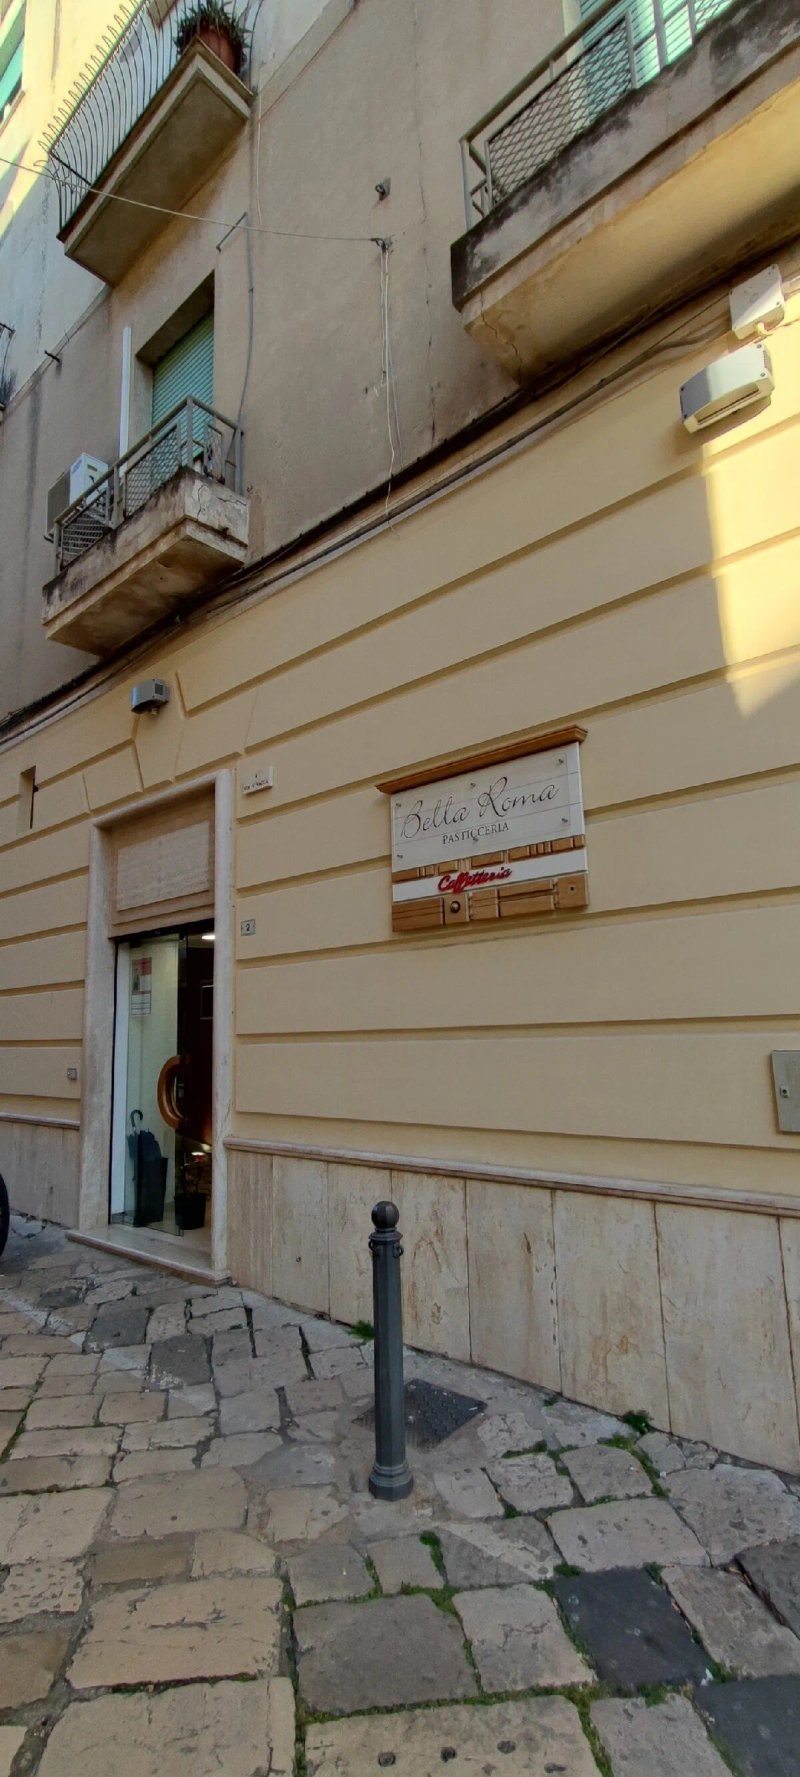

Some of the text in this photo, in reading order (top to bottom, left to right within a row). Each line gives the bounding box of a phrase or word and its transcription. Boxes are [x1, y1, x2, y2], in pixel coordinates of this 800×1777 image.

[401, 776, 559, 838] Bella Roma
[442, 822, 509, 844] PASTICCERIA
[437, 867, 512, 894] Caffetteria
